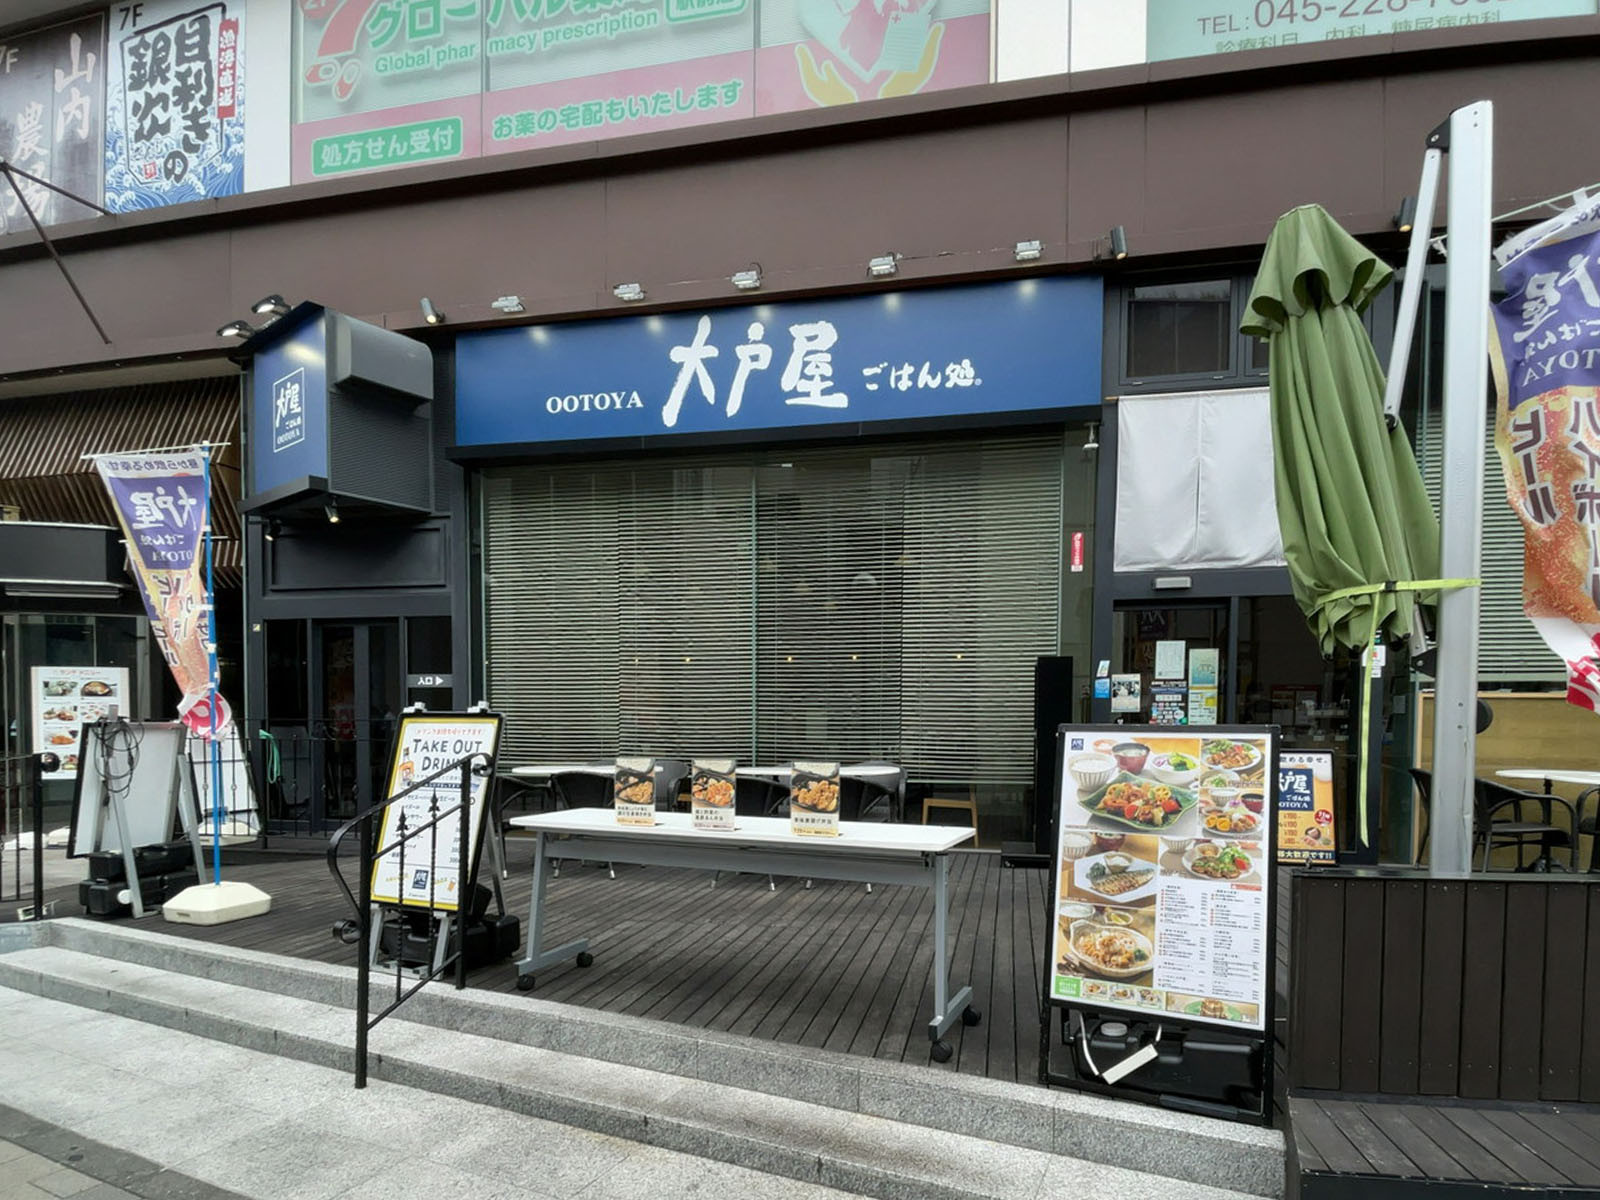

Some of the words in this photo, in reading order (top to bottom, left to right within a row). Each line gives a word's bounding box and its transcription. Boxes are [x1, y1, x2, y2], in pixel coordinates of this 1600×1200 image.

[119, 4, 143, 31] 7F
[375, 53, 430, 73] Global
[543, 11, 657, 47] prescription
[54, 33, 96, 142] 山内
[493, 80, 743, 139] お薬の宅配もいたします
[321, 126, 454, 169] 処方せん受付
[662, 315, 849, 427] 大戸屋
[546, 390, 644, 414] OOTOYA
[417, 676, 433, 686] 入口
[413, 738, 448, 753] TAKE
[453, 739, 483, 754] OUT
